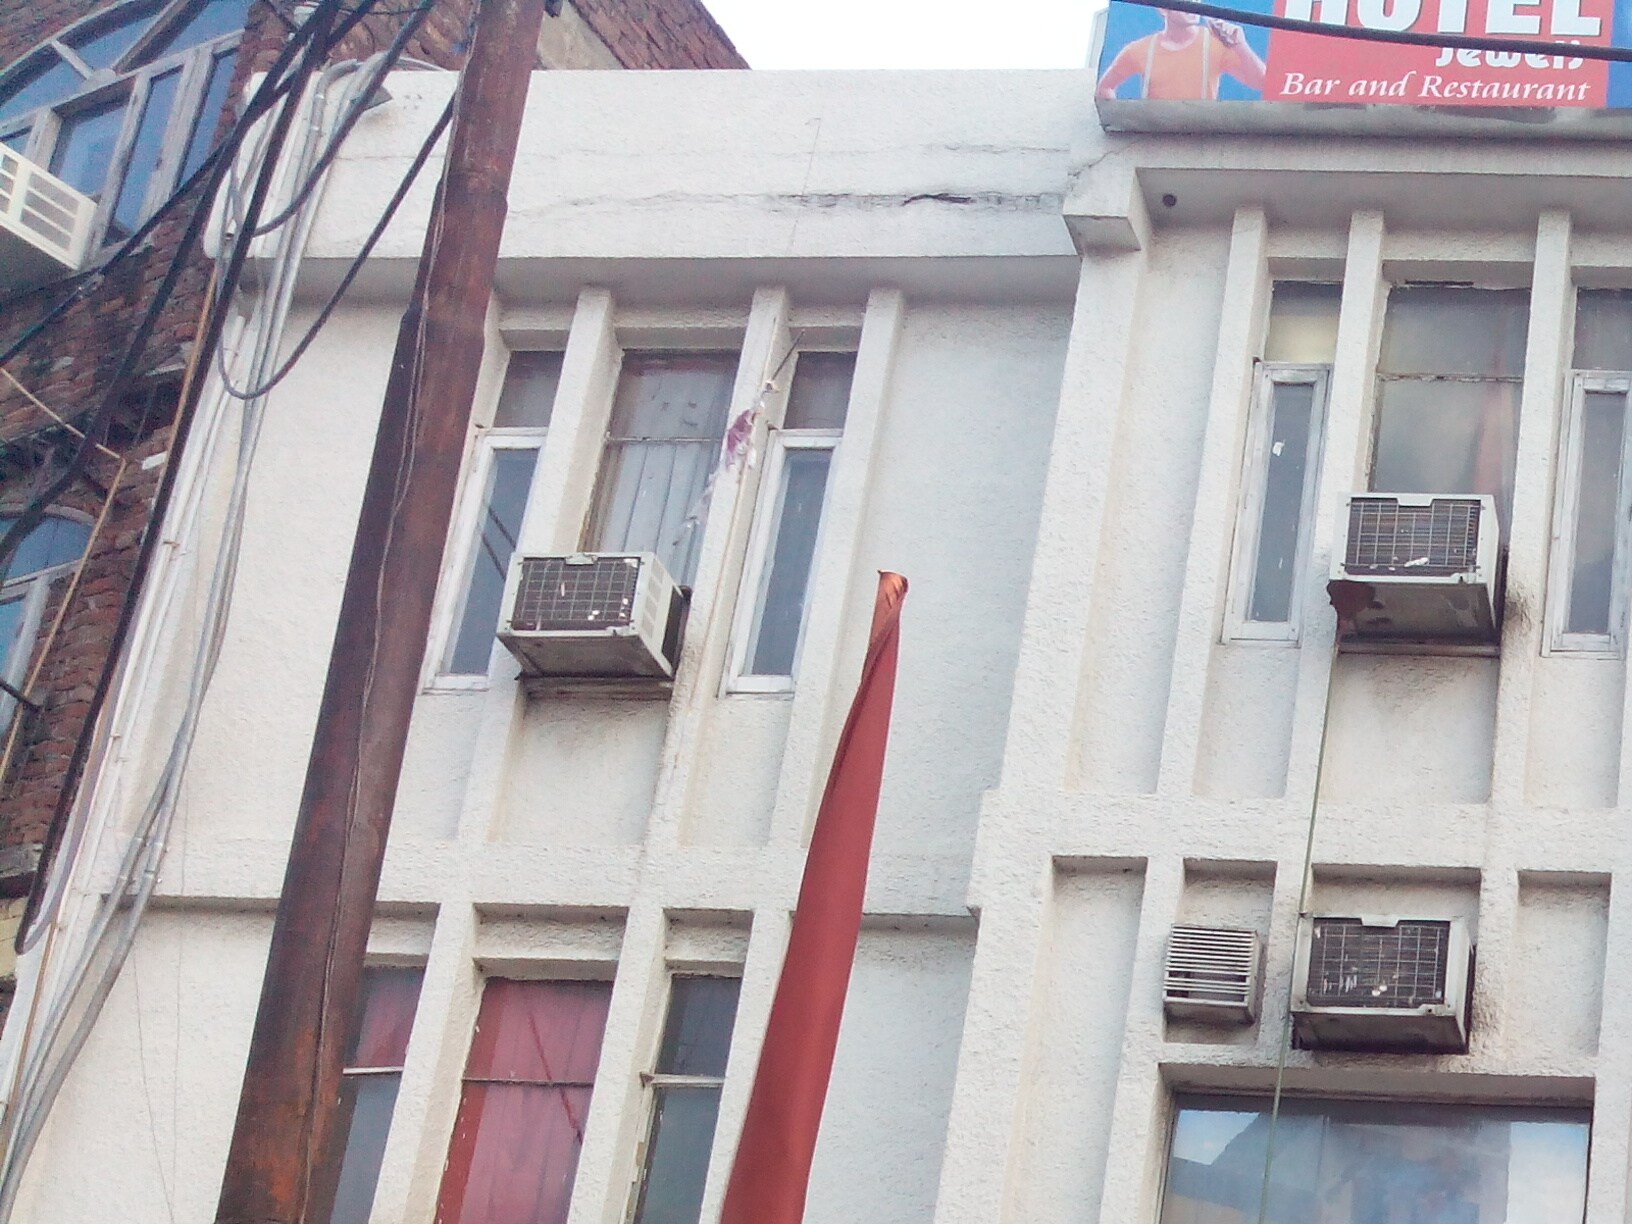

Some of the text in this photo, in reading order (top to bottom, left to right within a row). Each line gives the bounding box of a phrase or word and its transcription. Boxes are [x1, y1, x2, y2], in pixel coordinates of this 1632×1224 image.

[1280, 71, 1591, 101] Bar and Restaurant
